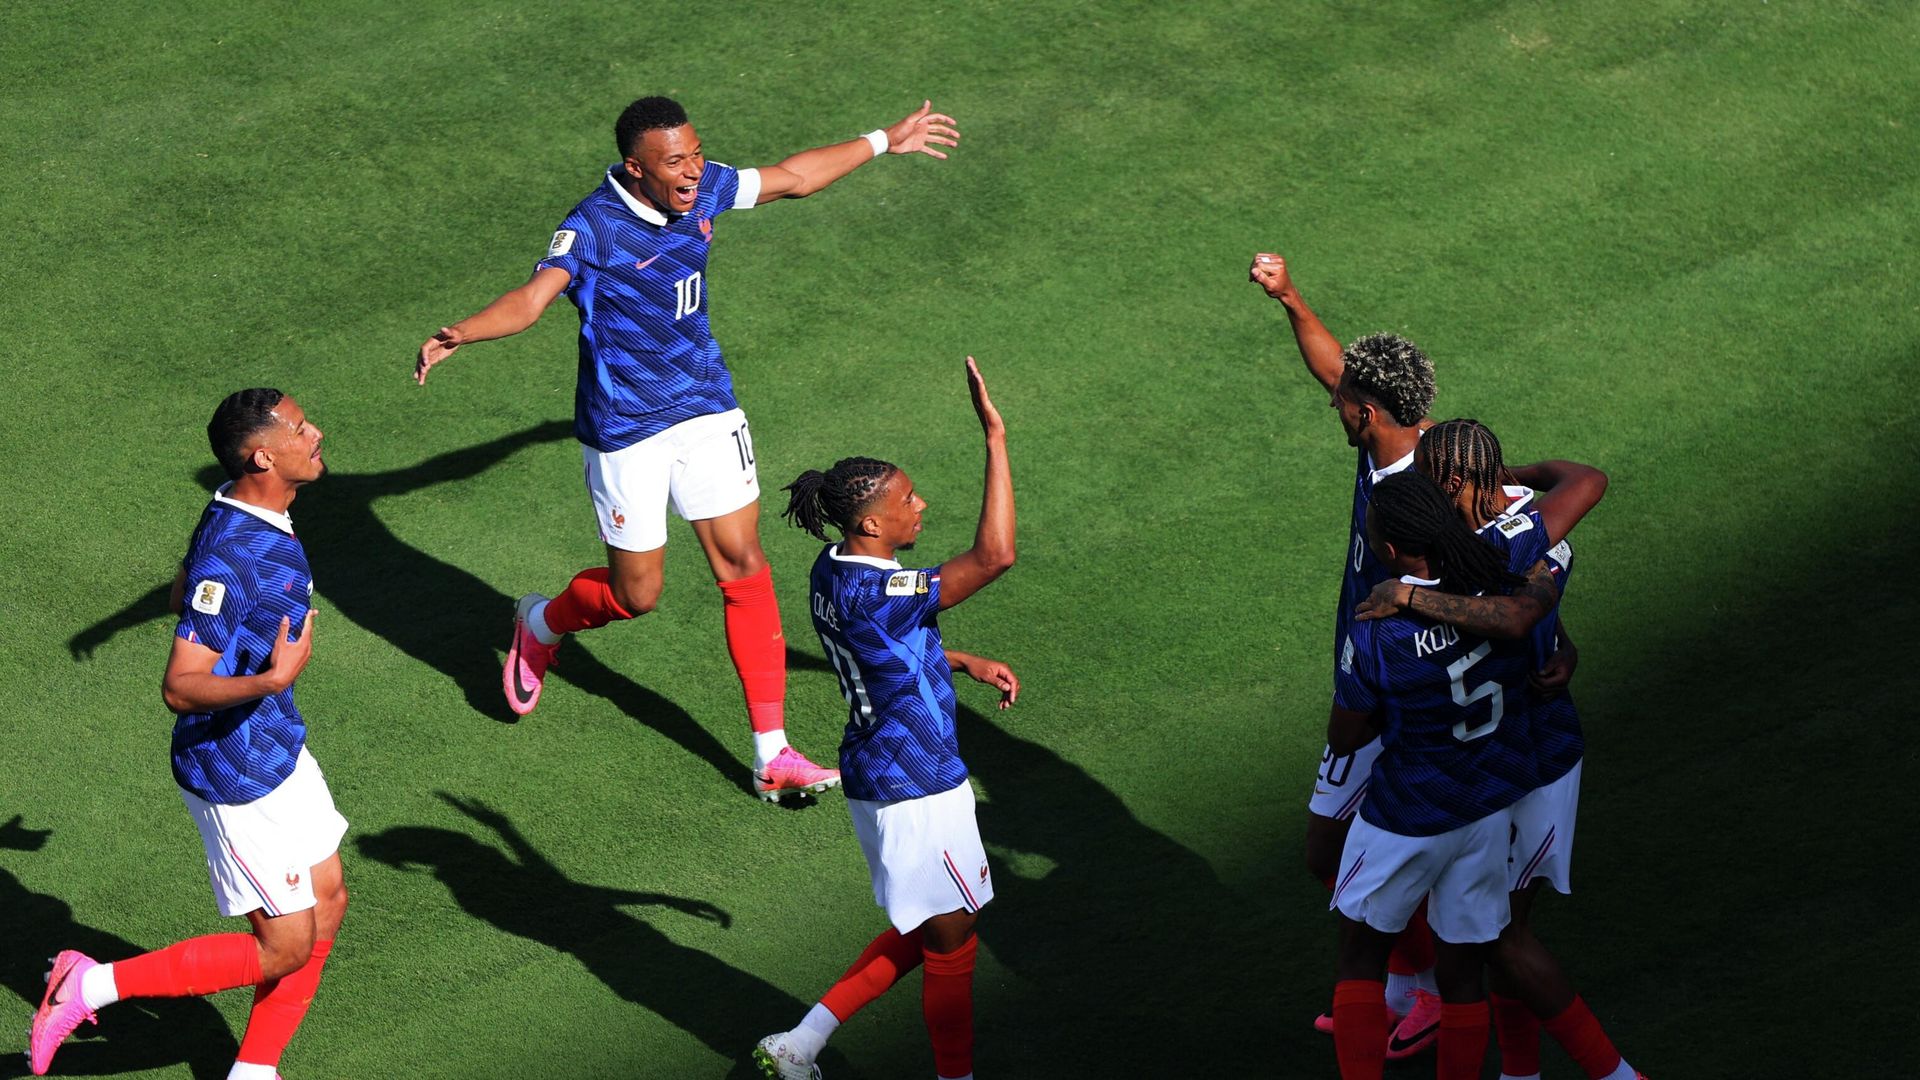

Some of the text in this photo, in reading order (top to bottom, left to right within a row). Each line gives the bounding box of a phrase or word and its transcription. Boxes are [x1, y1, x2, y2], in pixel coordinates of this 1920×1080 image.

[674, 271, 701, 320] 10
[813, 592, 840, 632] OLISE
[821, 633, 877, 728] 11
[1446, 640, 1504, 742] 5
